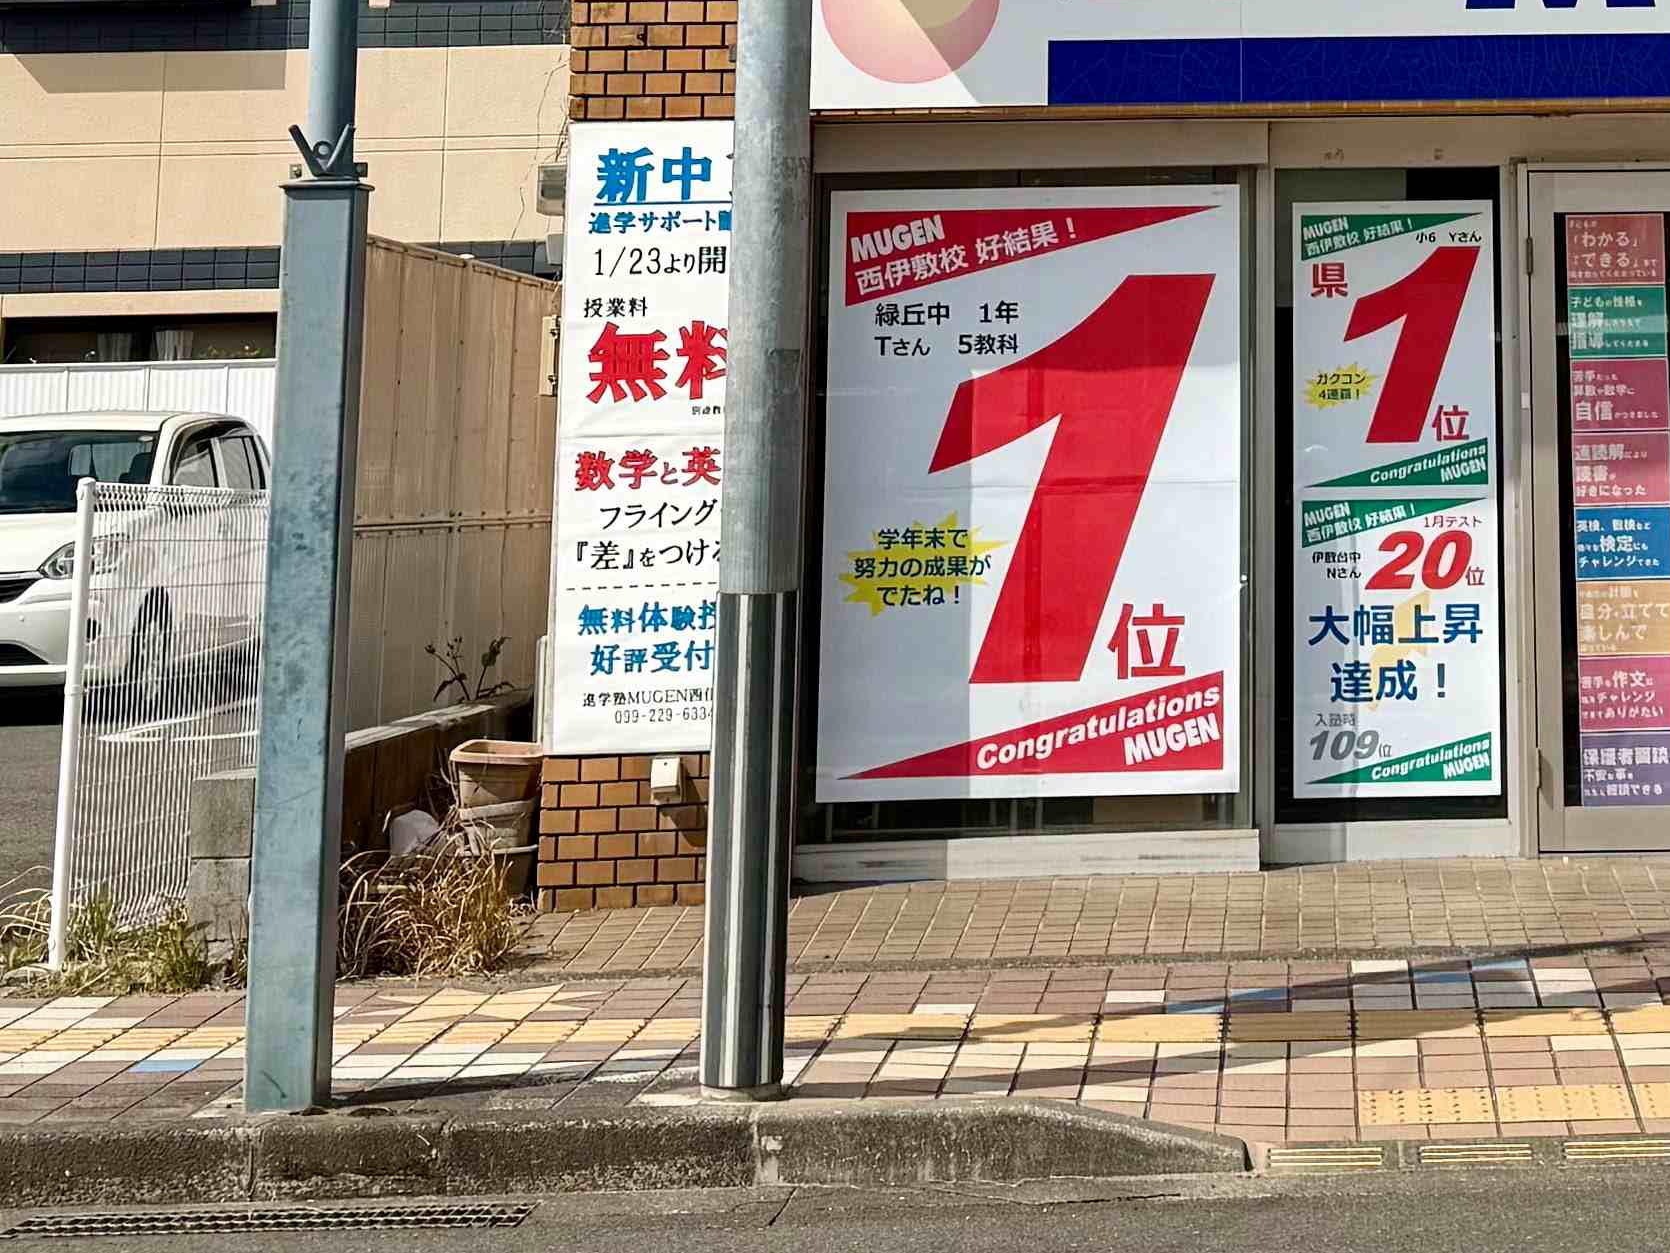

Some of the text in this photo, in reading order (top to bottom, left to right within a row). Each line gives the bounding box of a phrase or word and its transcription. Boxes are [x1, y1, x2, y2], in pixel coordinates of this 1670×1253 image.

[597, 147, 734, 203] 新中
[851, 215, 945, 263] MUGEN
[1303, 216, 1349, 241] MUGEN
[855, 244, 969, 295] 西伊敷校
[583, 296, 649, 318] 授業料
[979, 301, 1019, 325] 1年
[586, 320, 728, 404] 無料
[875, 333, 1018, 356] Tさん 5教科
[1311, 263, 1348, 298] 県
[1432, 405, 1470, 442] 位
[575, 446, 721, 491] 数学と英
[1370, 443, 1488, 484] Congratulations
[1440, 457, 1487, 483] MUGEN
[1303, 502, 1351, 526] MUGEN
[1424, 515, 1483, 530] 1月テスト
[878, 528, 968, 549] 学年末で
[854, 554, 991, 579] 努力の成果が
[877, 584, 960, 607] でたね！
[1308, 603, 1483, 647] 大幅上昇
[590, 639, 715, 676] 好評受付
[1331, 660, 1447, 704] 達成！
[976, 685, 1220, 770] Congratulations
[1123, 712, 1220, 766] MUGEN
[1371, 738, 1490, 782] Congratulations
[1443, 753, 1490, 781] MUGEN
